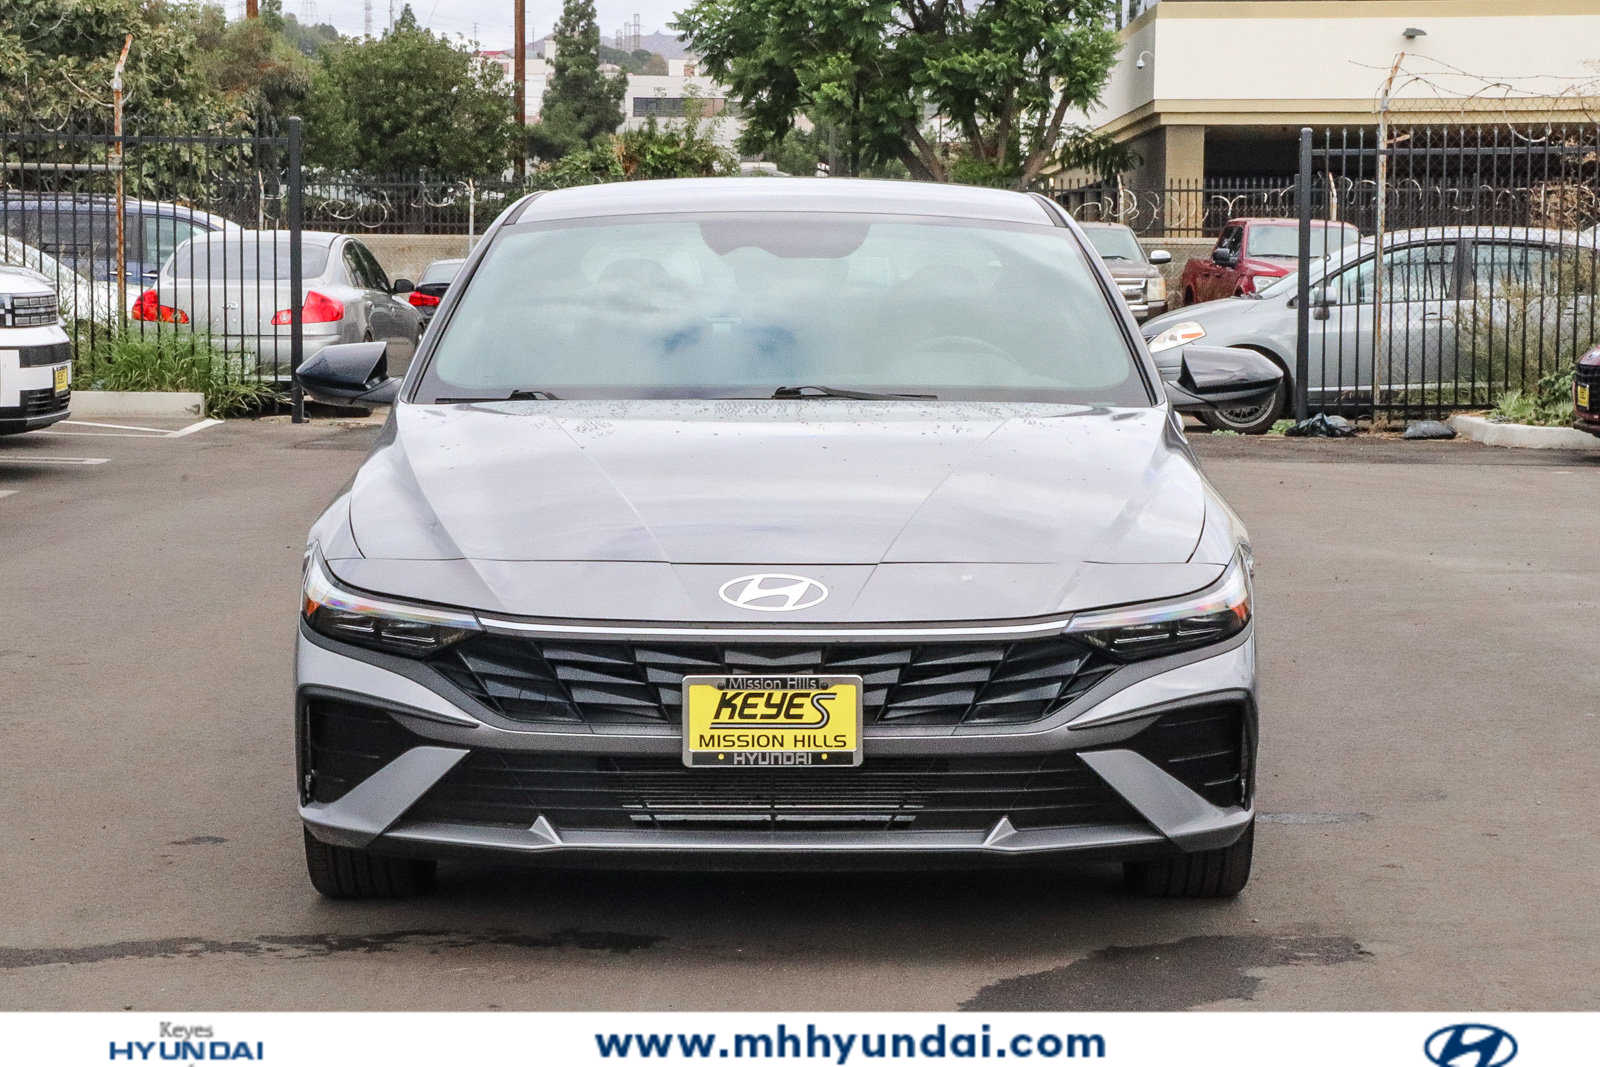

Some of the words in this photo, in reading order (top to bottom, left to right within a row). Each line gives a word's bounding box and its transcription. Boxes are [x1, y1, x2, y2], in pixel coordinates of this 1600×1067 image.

[728, 677, 782, 690] Mission
[787, 677, 817, 690] Hills
[709, 691, 838, 729] KEYES
[699, 734, 784, 748] MISSION
[794, 734, 847, 748] HILLS
[733, 752, 812, 765] HYUNDAI
